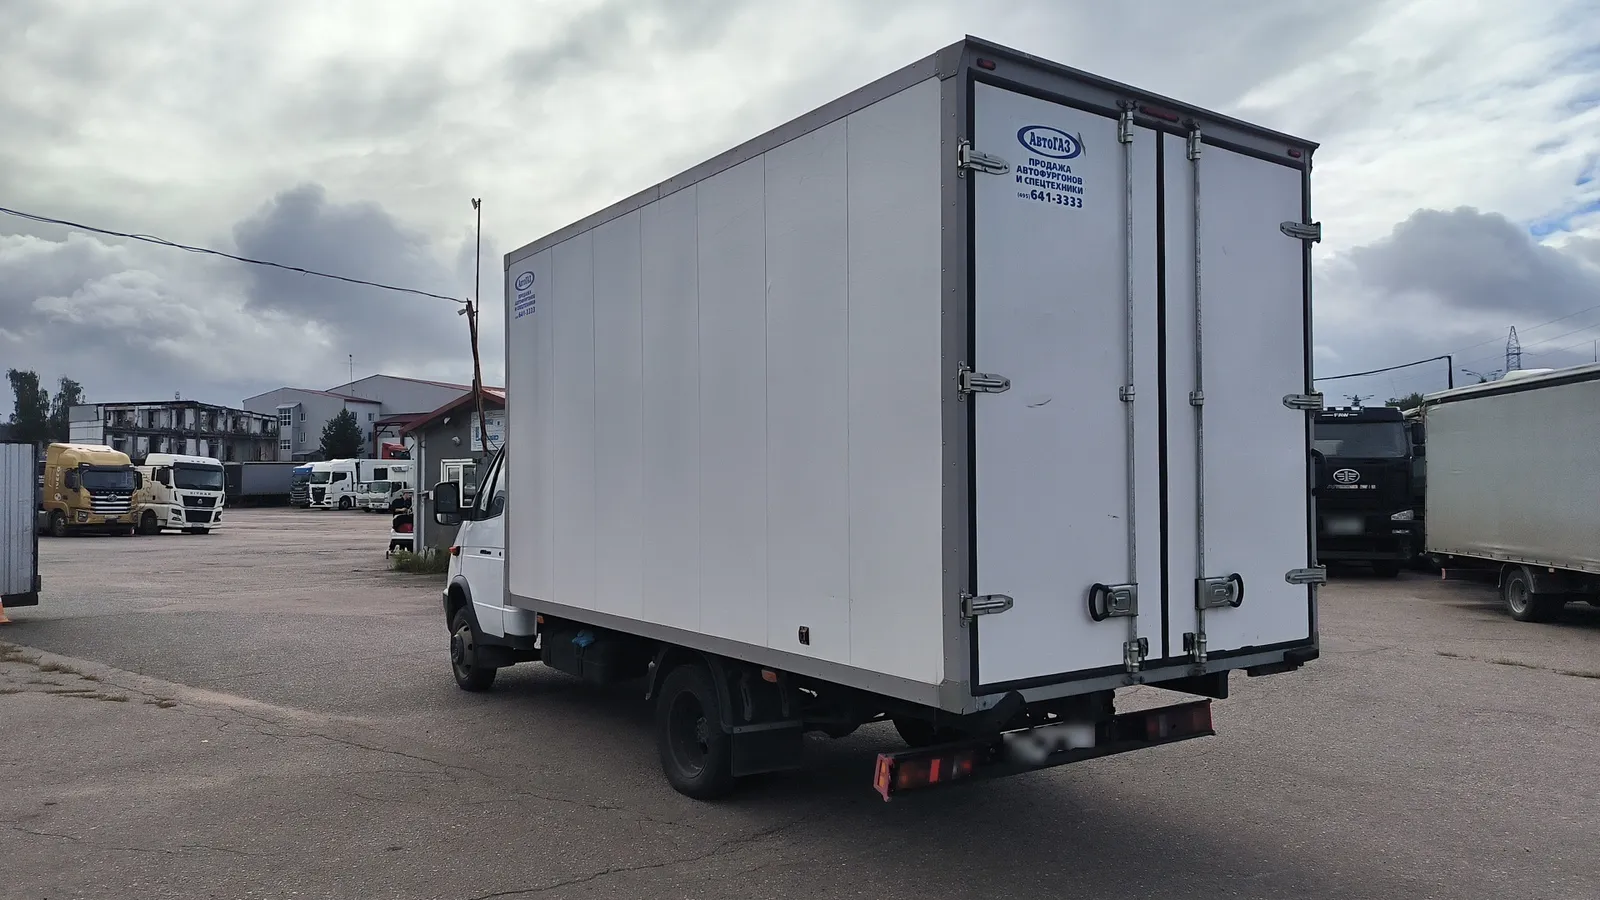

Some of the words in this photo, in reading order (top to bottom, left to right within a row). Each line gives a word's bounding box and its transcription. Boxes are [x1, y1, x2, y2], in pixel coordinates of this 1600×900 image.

[1029, 131, 1071, 153] АвтоГАЗ
[1028, 157, 1072, 173] ПРОДАЖА
[1016, 165, 1083, 185] АВТОФУРГОНОВ
[1016, 175, 1022, 183] И
[1024, 177, 1083, 194] СПЕЦТЕХНИКИ
[1030, 189, 1083, 208] 641-3333
